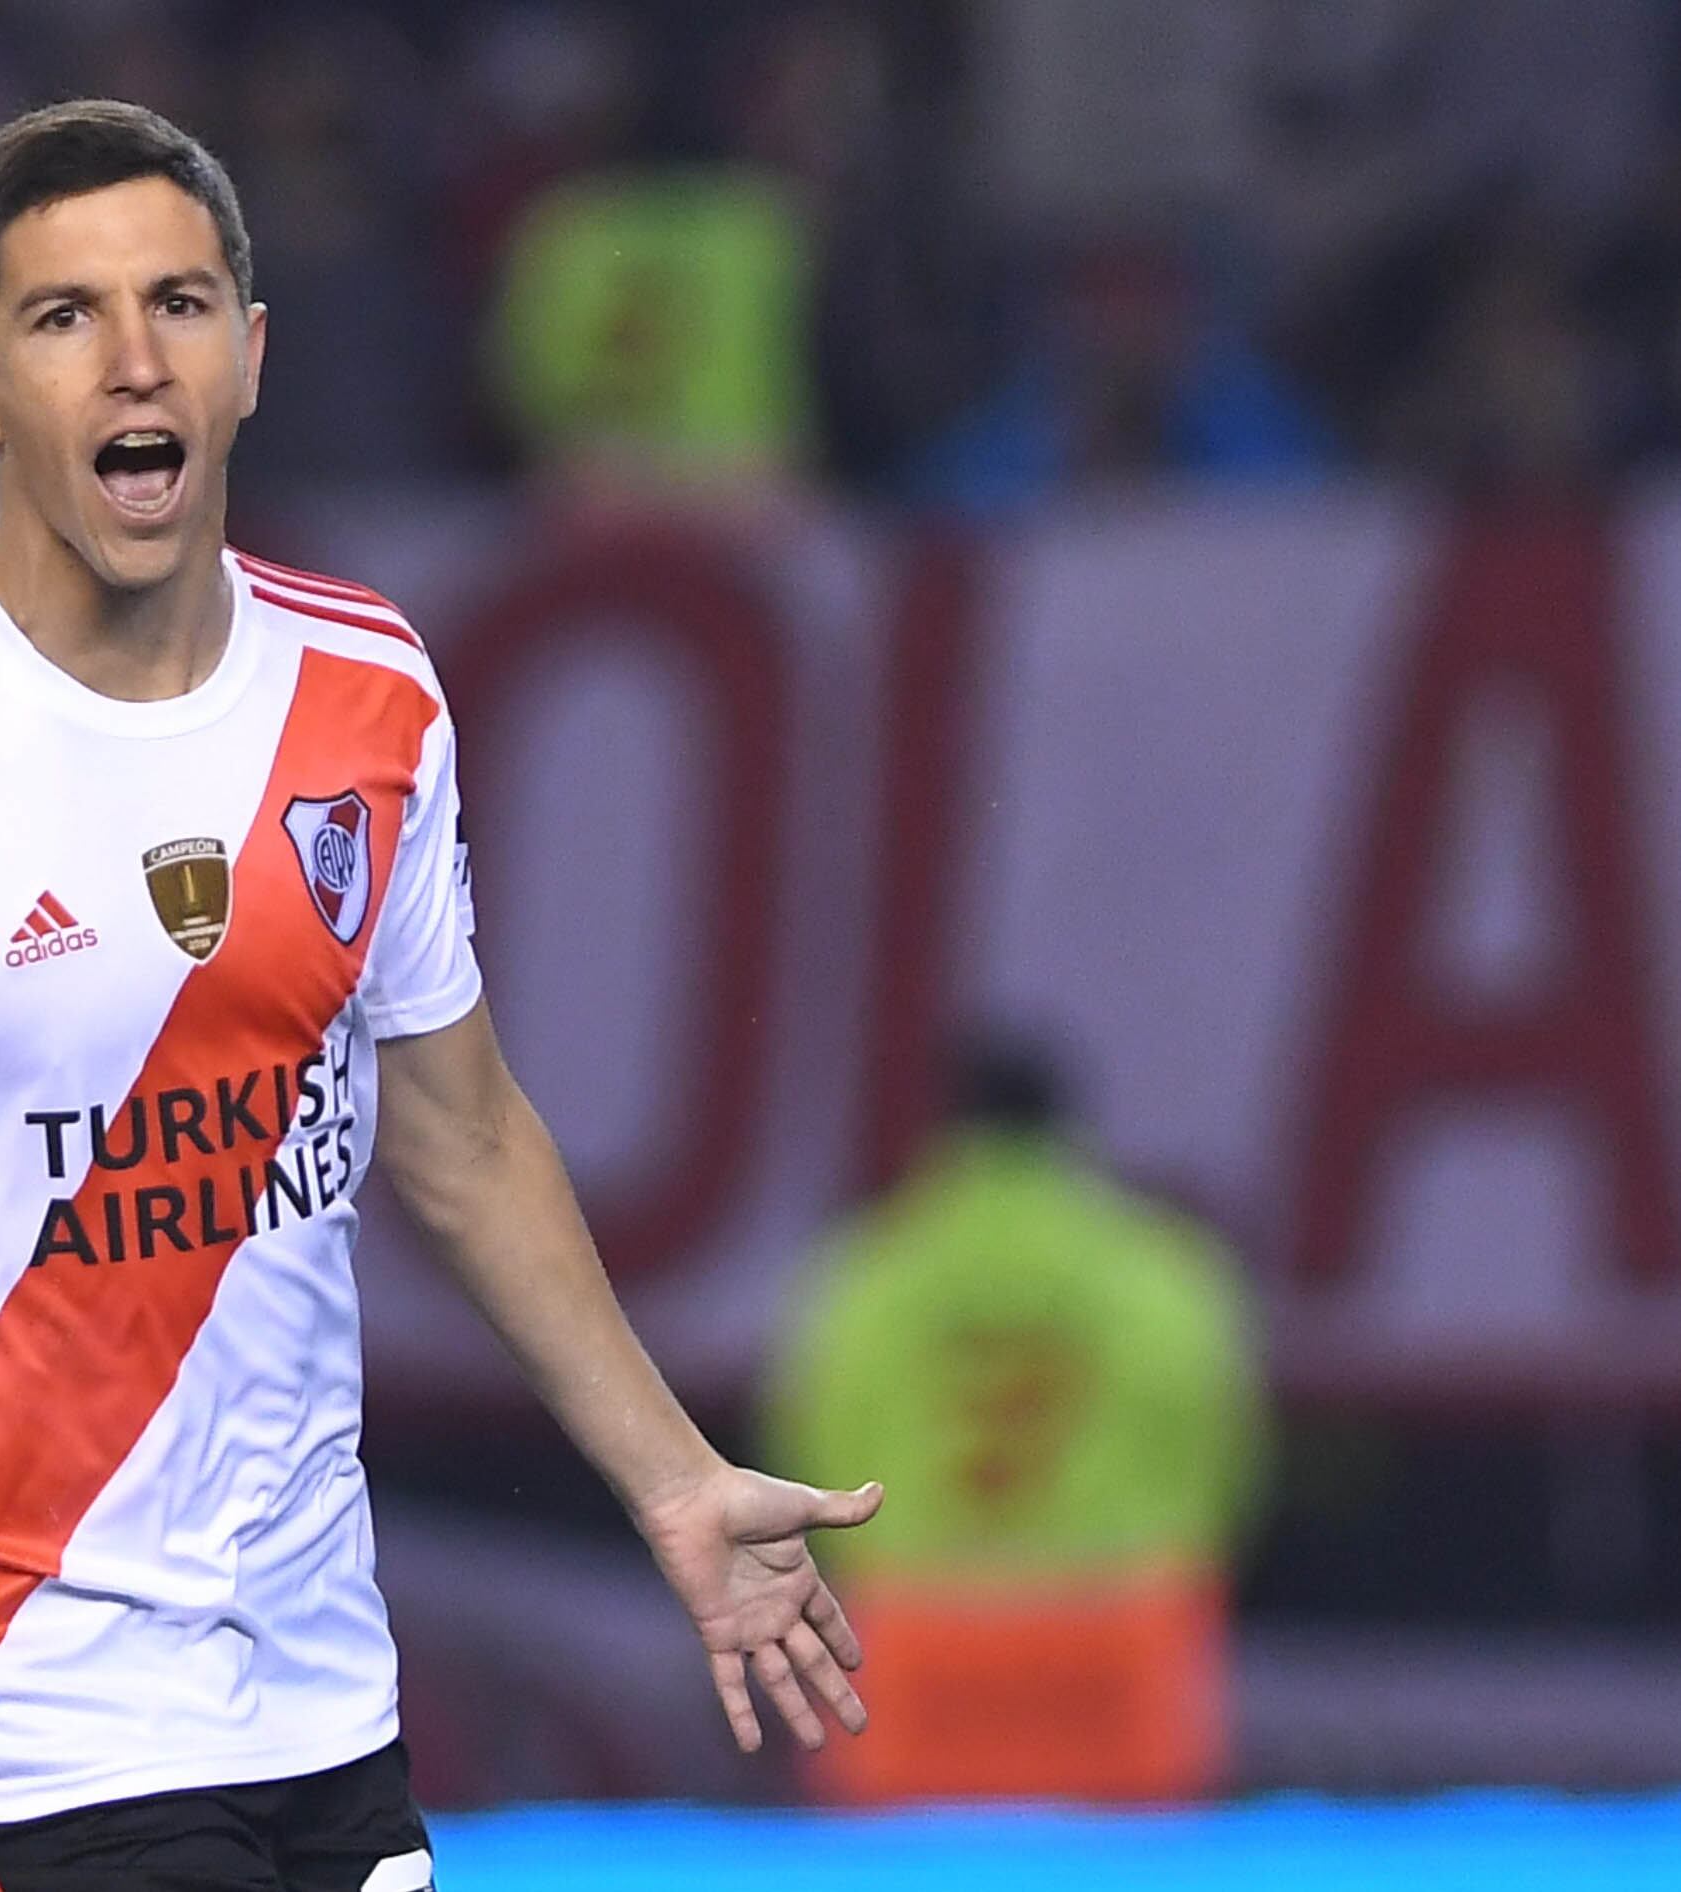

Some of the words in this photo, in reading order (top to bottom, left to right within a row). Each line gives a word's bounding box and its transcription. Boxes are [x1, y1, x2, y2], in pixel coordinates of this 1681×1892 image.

[5, 928, 98, 968] adidas
[25, 1031, 354, 1178] TURKISH
[29, 1116, 356, 1268] AIRLINES
